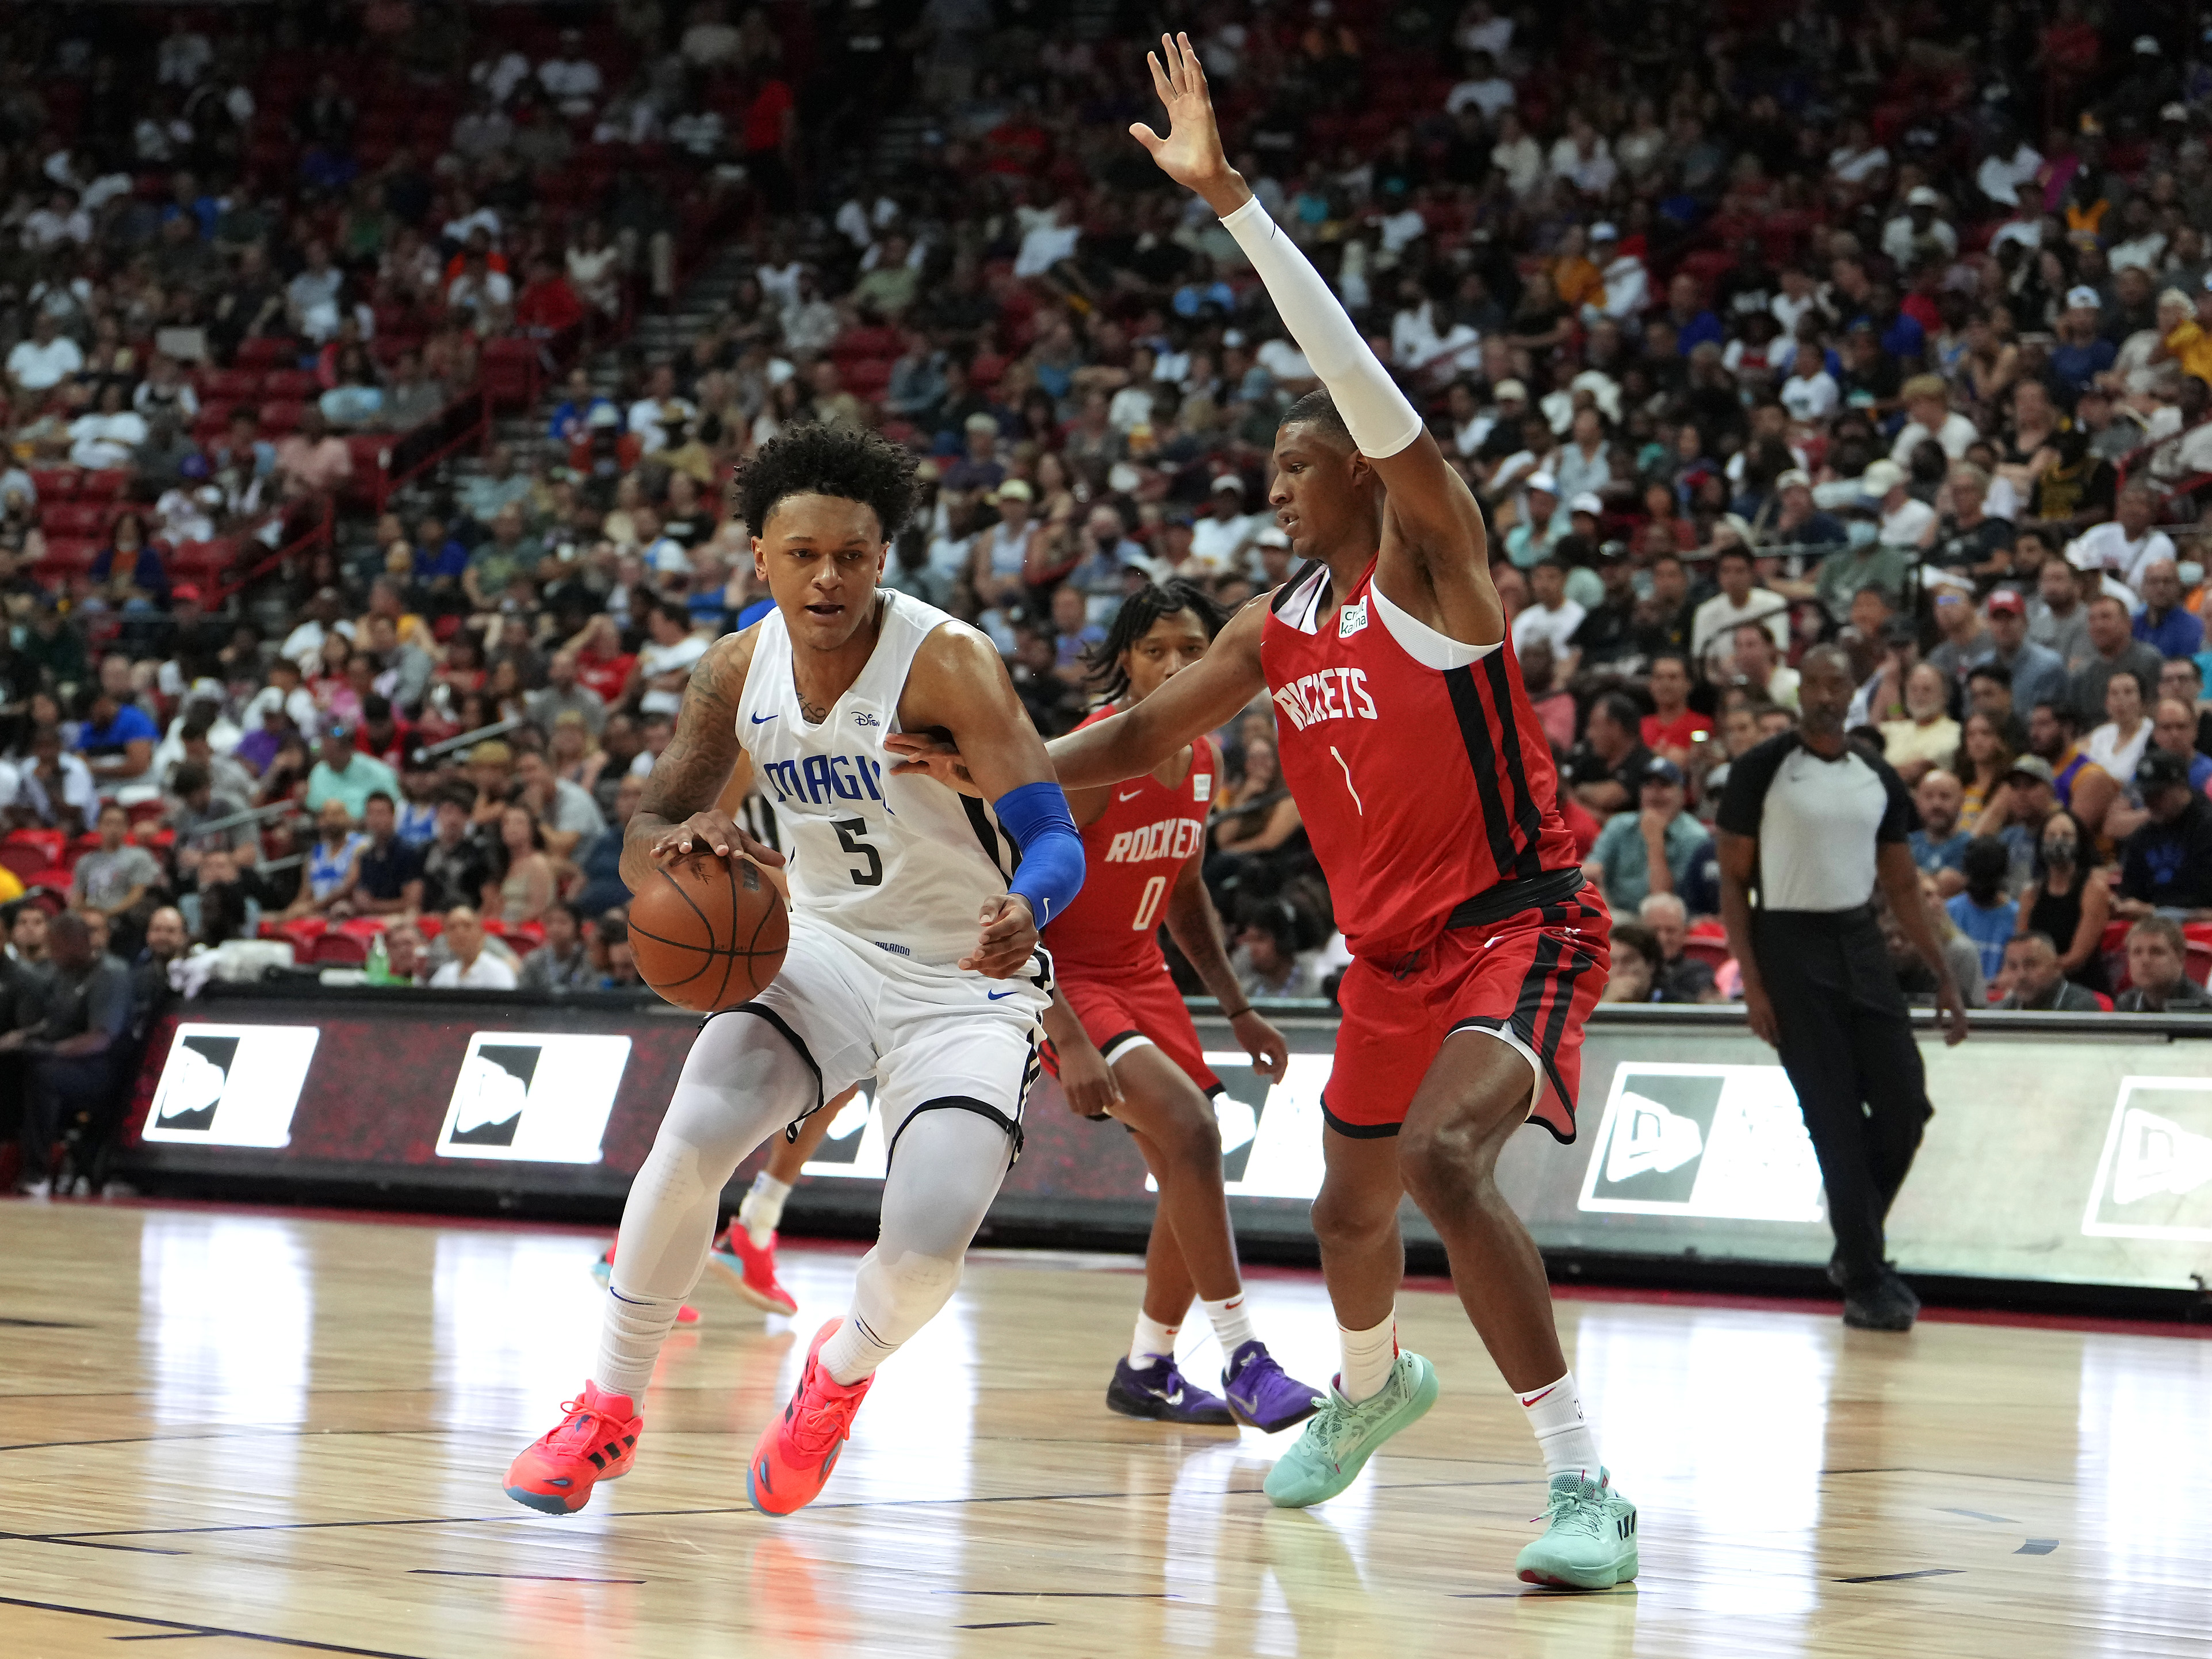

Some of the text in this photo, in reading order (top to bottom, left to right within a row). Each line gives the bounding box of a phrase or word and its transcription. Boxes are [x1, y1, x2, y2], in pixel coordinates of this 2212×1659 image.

[1341, 615, 1366, 634] kama
[1345, 601, 1364, 620] crit
[851, 711, 880, 726] Disn
[764, 754, 895, 815] MAGI
[1330, 746, 1362, 816] 1
[830, 817, 883, 886] 5
[1132, 876, 1166, 931] 0
[875, 941, 910, 956] ORLANDO
